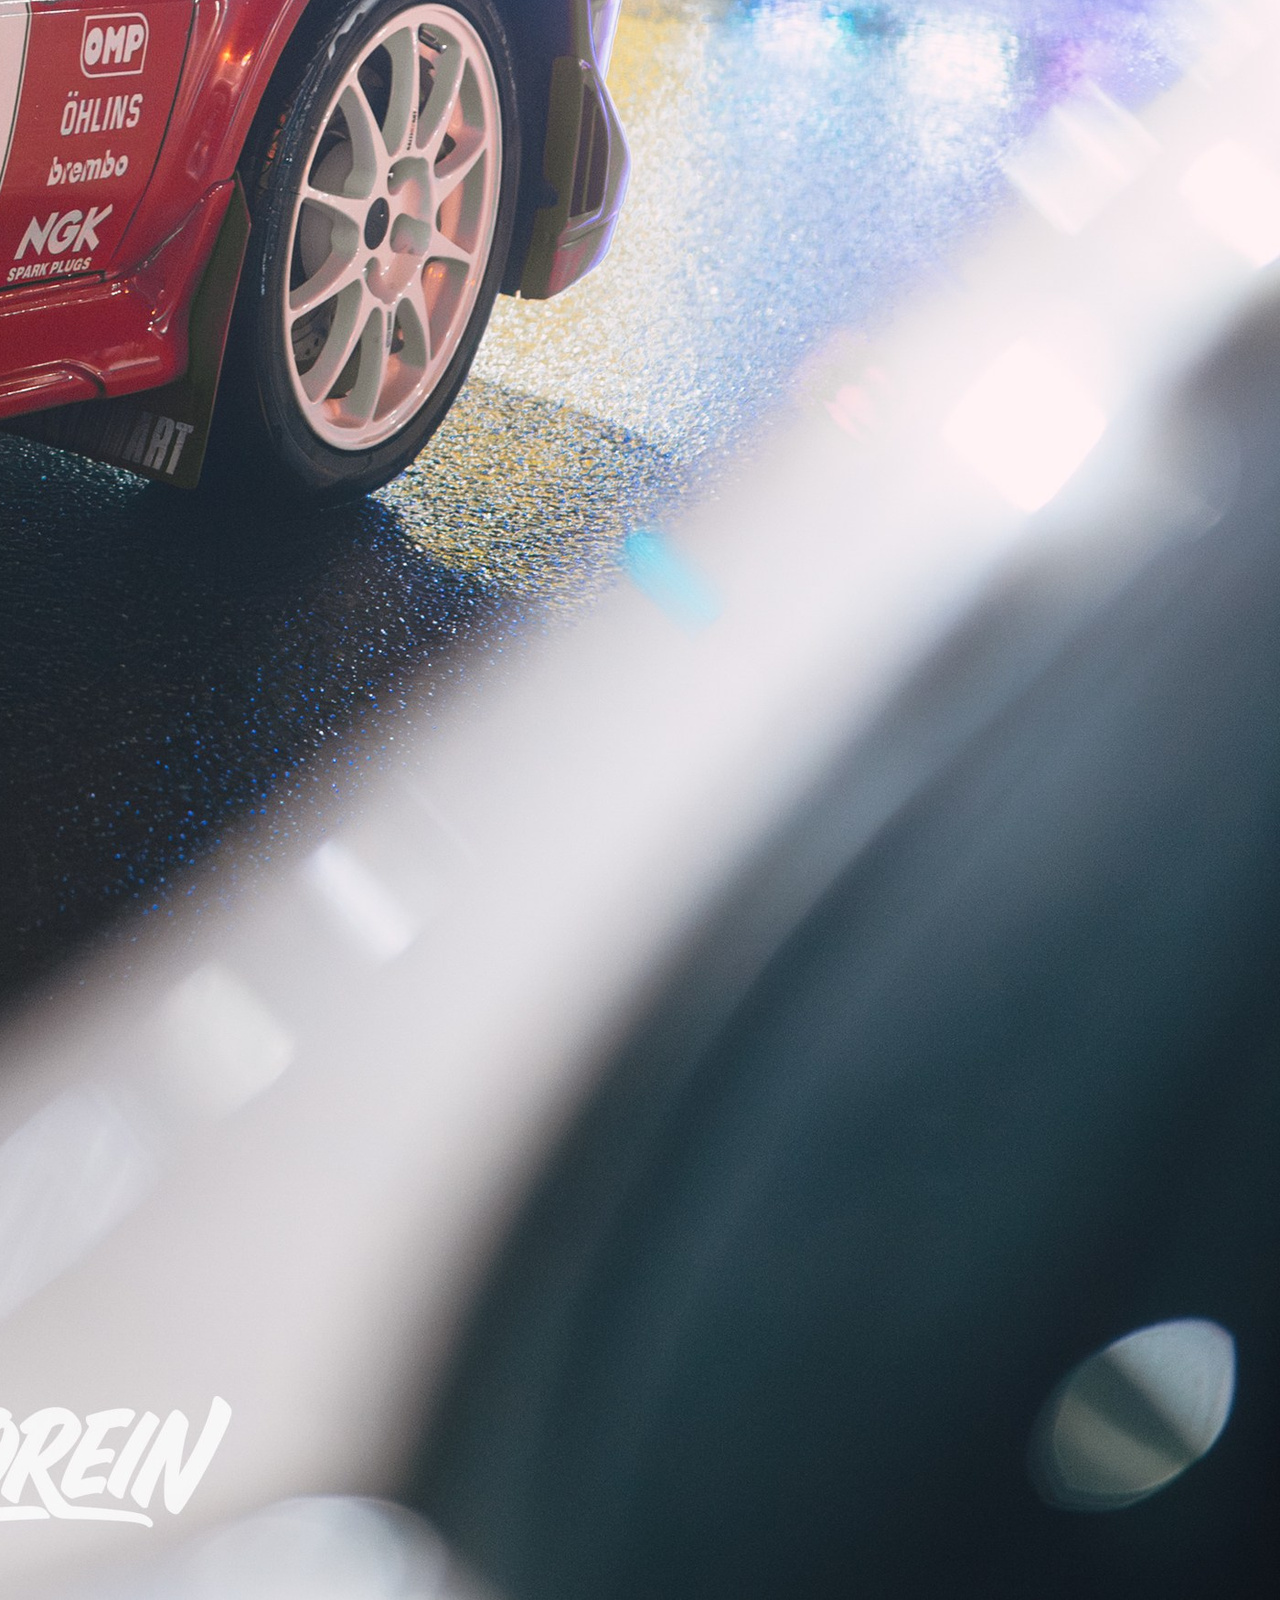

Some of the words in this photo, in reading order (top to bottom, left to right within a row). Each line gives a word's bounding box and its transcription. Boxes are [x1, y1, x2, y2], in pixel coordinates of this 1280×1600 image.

[84, 24, 144, 66] OMP
[60, 91, 144, 136] ÖHLINS
[47, 150, 129, 187] brembo
[13, 203, 114, 260] NGK
[7, 261, 51, 282] SPARK
[48, 257, 92, 275] PLUGS
